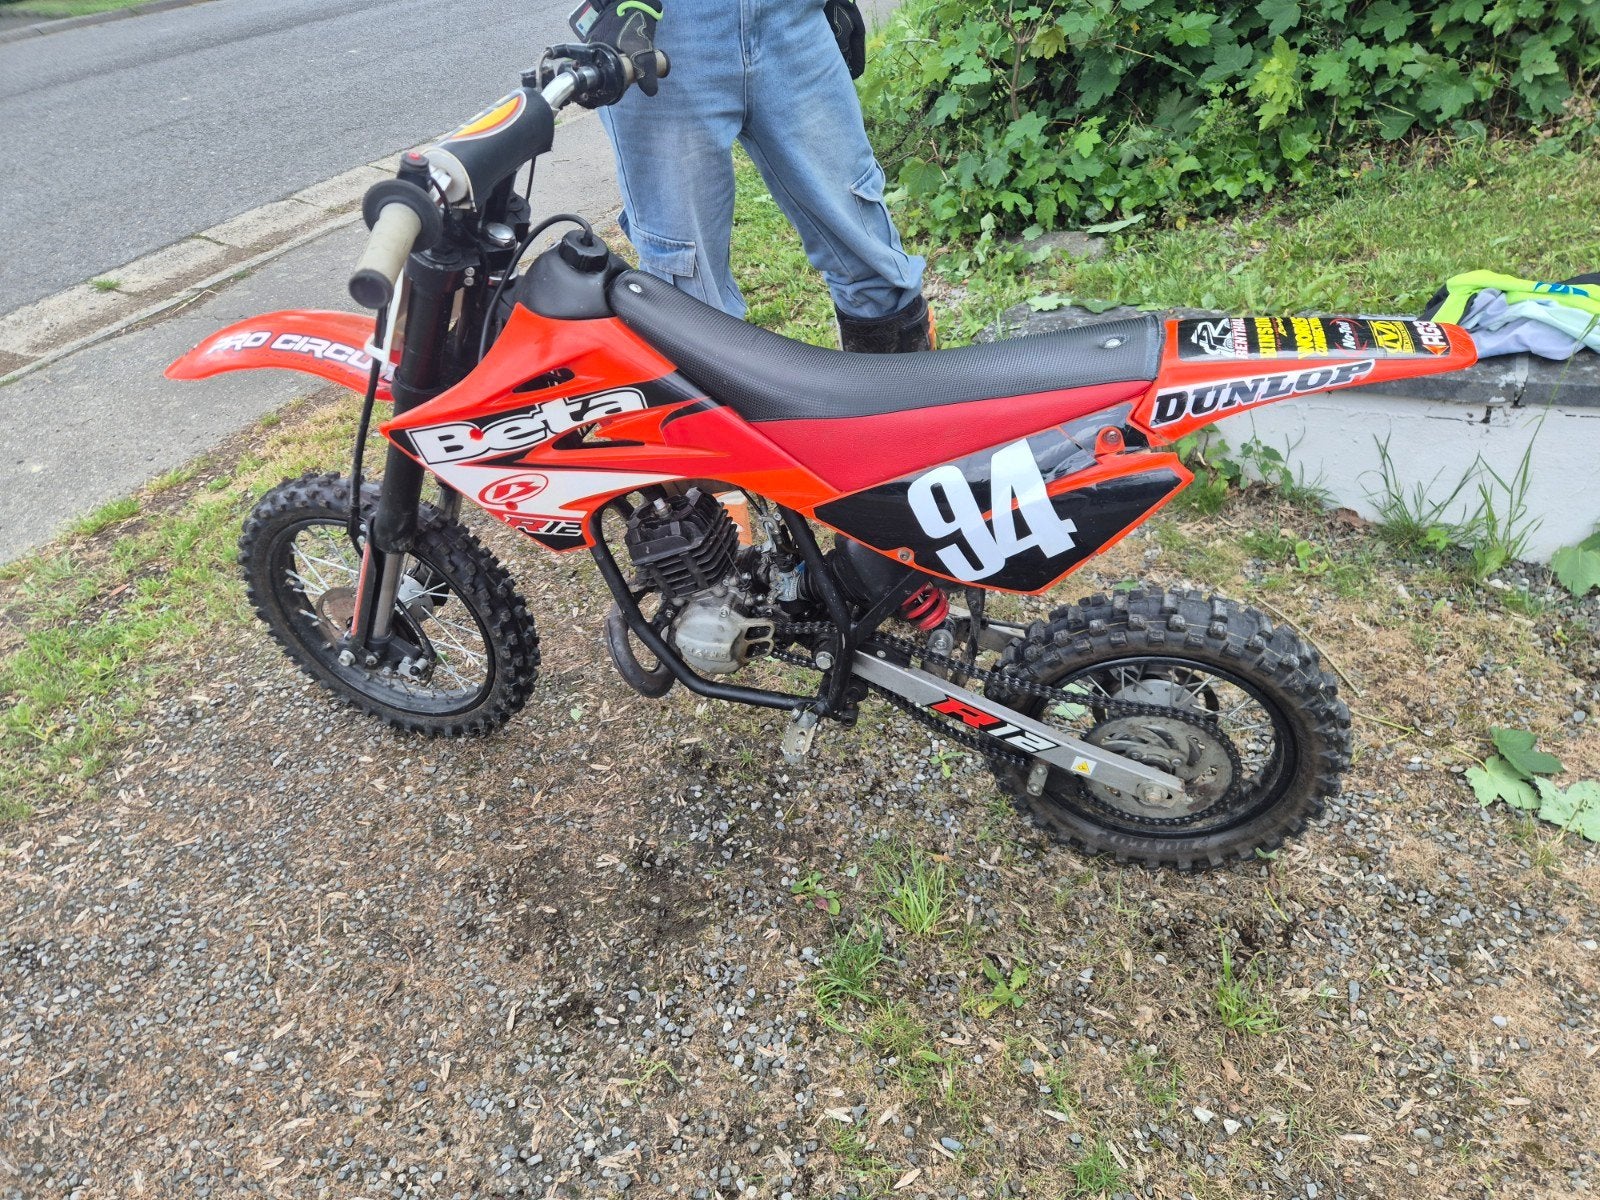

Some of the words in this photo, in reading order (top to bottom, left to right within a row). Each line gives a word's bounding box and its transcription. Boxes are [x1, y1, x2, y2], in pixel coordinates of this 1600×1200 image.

[271, 333, 396, 382] CIRCU
[1151, 358, 1375, 427] DUNLOP
[405, 387, 649, 465] Beta
[907, 438, 1078, 582] 94
